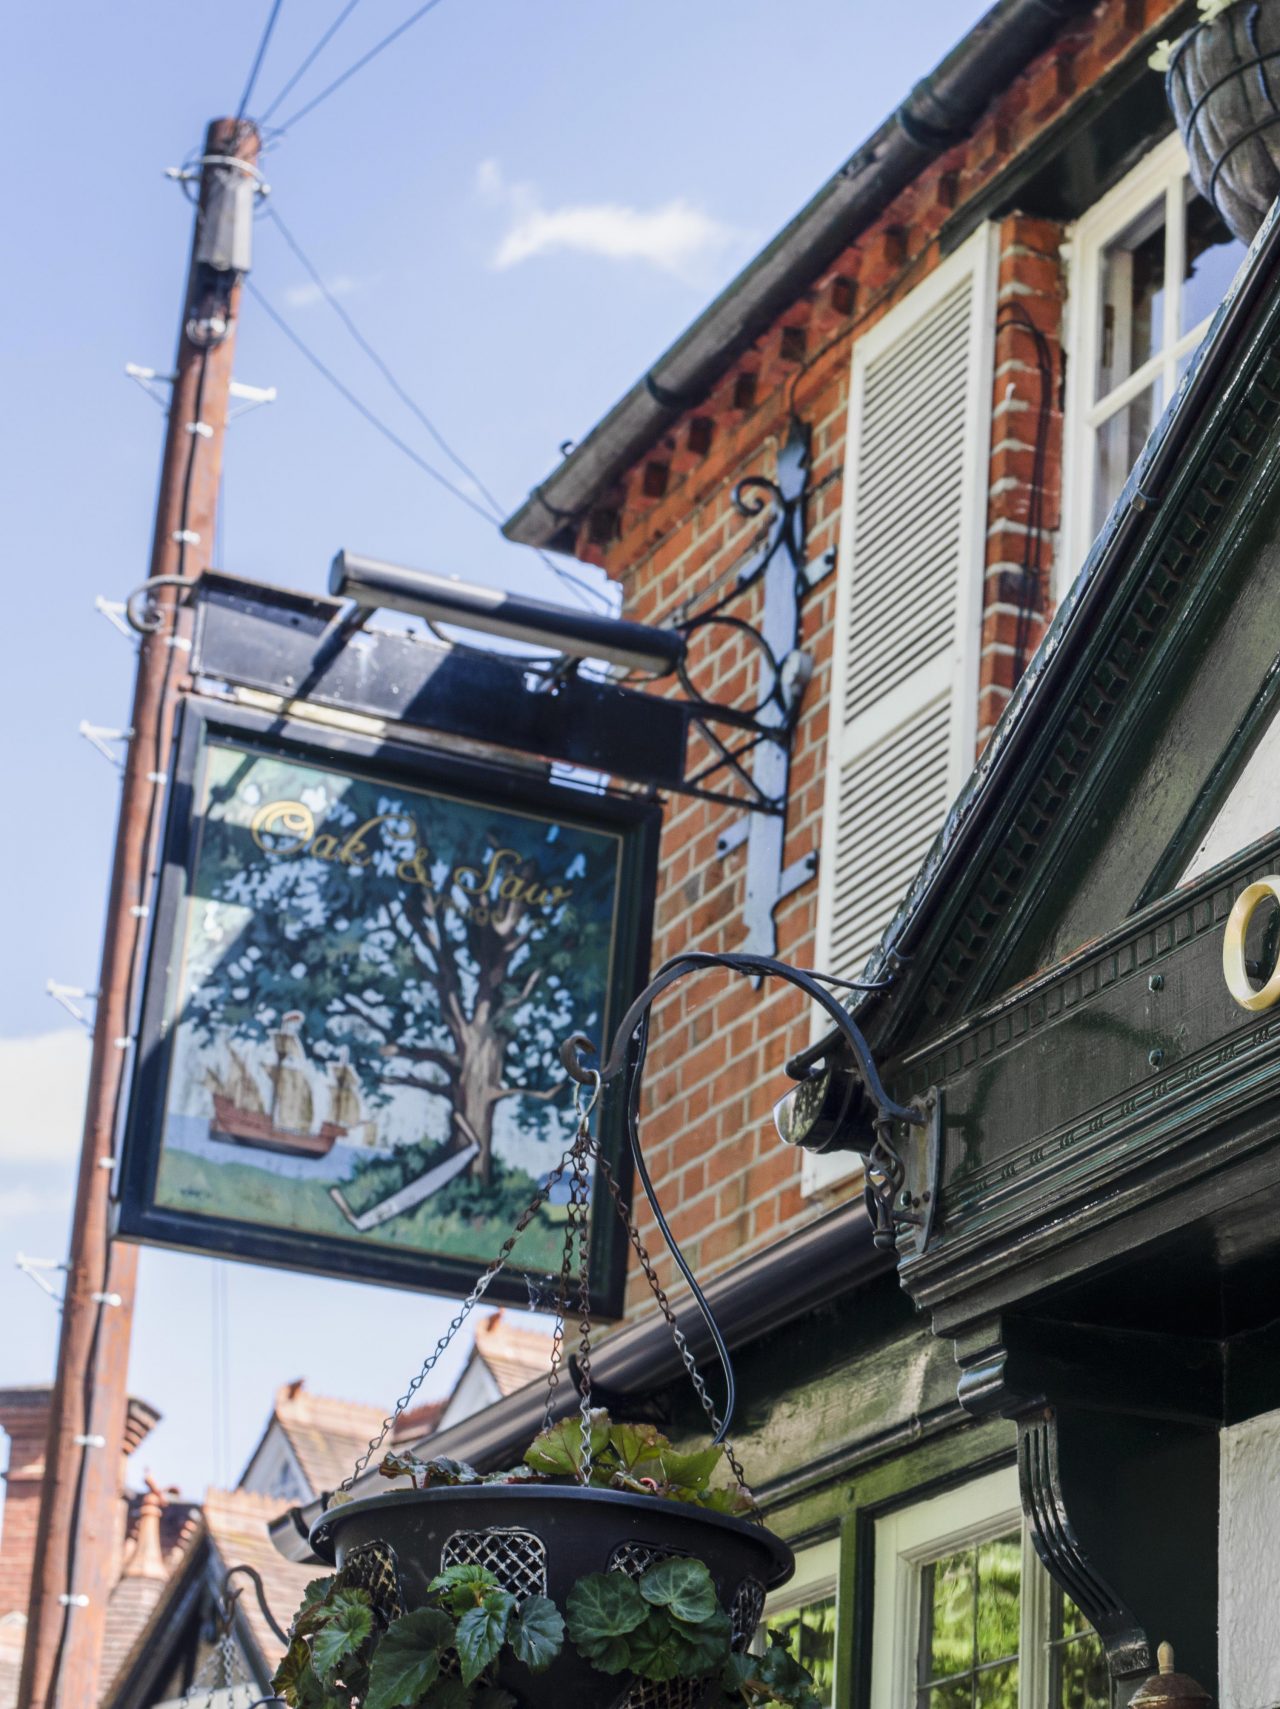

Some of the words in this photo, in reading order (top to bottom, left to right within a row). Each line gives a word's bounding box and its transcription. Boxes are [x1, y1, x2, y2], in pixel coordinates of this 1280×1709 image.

[251, 800, 417, 867] Oak
[399, 848, 434, 888] &
[453, 848, 573, 906] Saw
